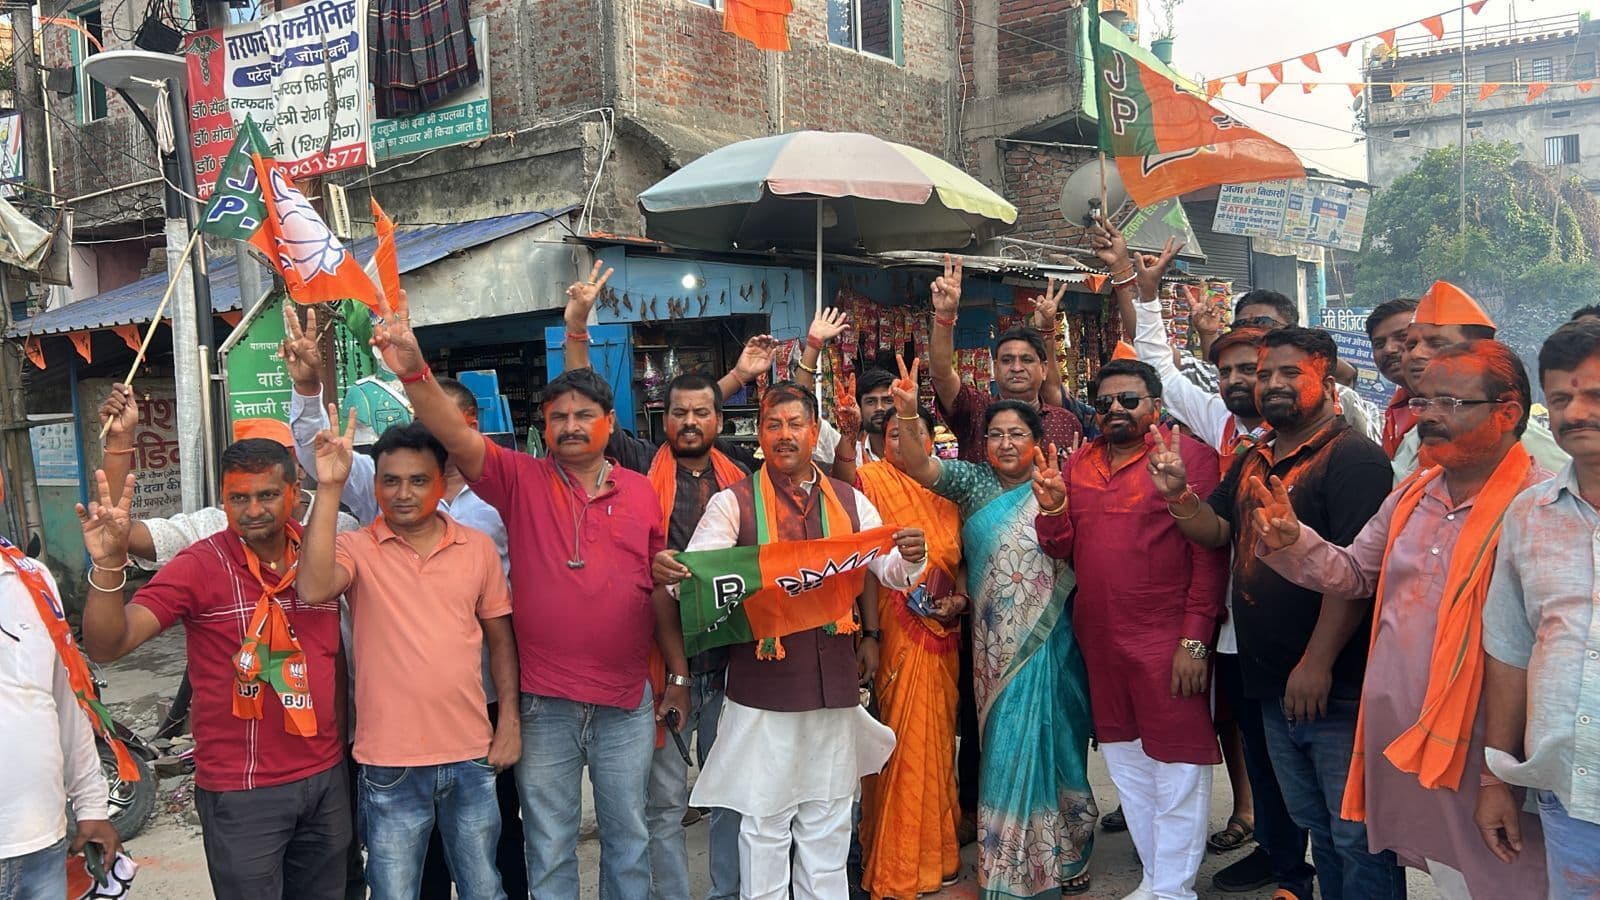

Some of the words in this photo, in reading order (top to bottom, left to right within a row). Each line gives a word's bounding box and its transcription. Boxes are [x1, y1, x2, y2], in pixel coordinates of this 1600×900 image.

[282, 0, 355, 40] क्लीनिक
[301, 106, 320, 123] रोग
[1228, 205, 1248, 216] ATM
[257, 366, 285, 387] वार्ड
[234, 397, 277, 416] नेताजी
